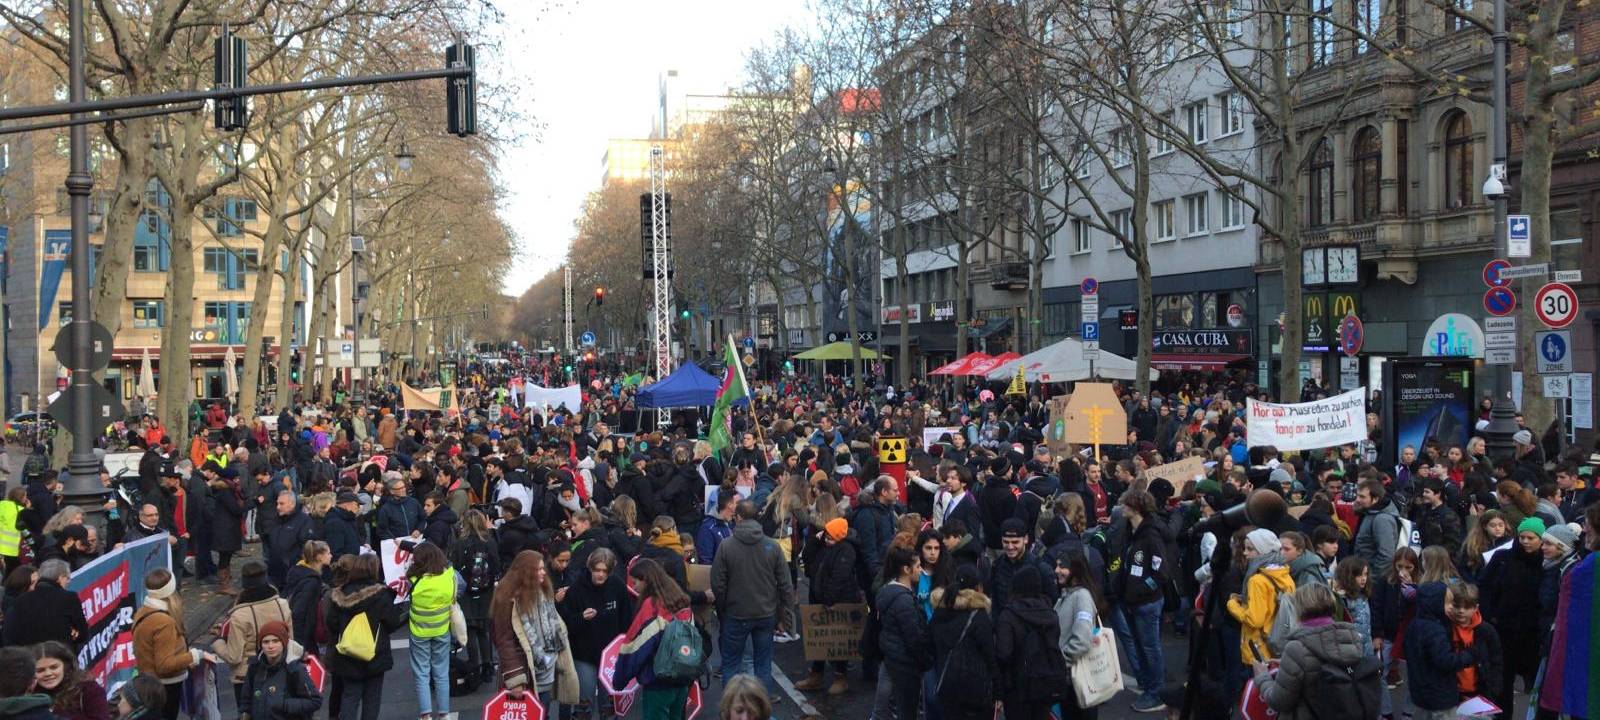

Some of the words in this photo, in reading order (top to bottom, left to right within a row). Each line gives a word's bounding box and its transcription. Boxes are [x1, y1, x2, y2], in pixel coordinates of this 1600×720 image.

[1544, 295, 1568, 315] 30
[1162, 333, 1192, 346] CASA
[1194, 333, 1230, 346] CUBA
[1272, 406, 1286, 417] auf
[1289, 403, 1330, 416] Ausreden
[1296, 426, 1305, 434] an
[1307, 424, 1316, 433] zu
[503, 702, 527, 711] GroKo
[500, 711, 528, 720] STOP
